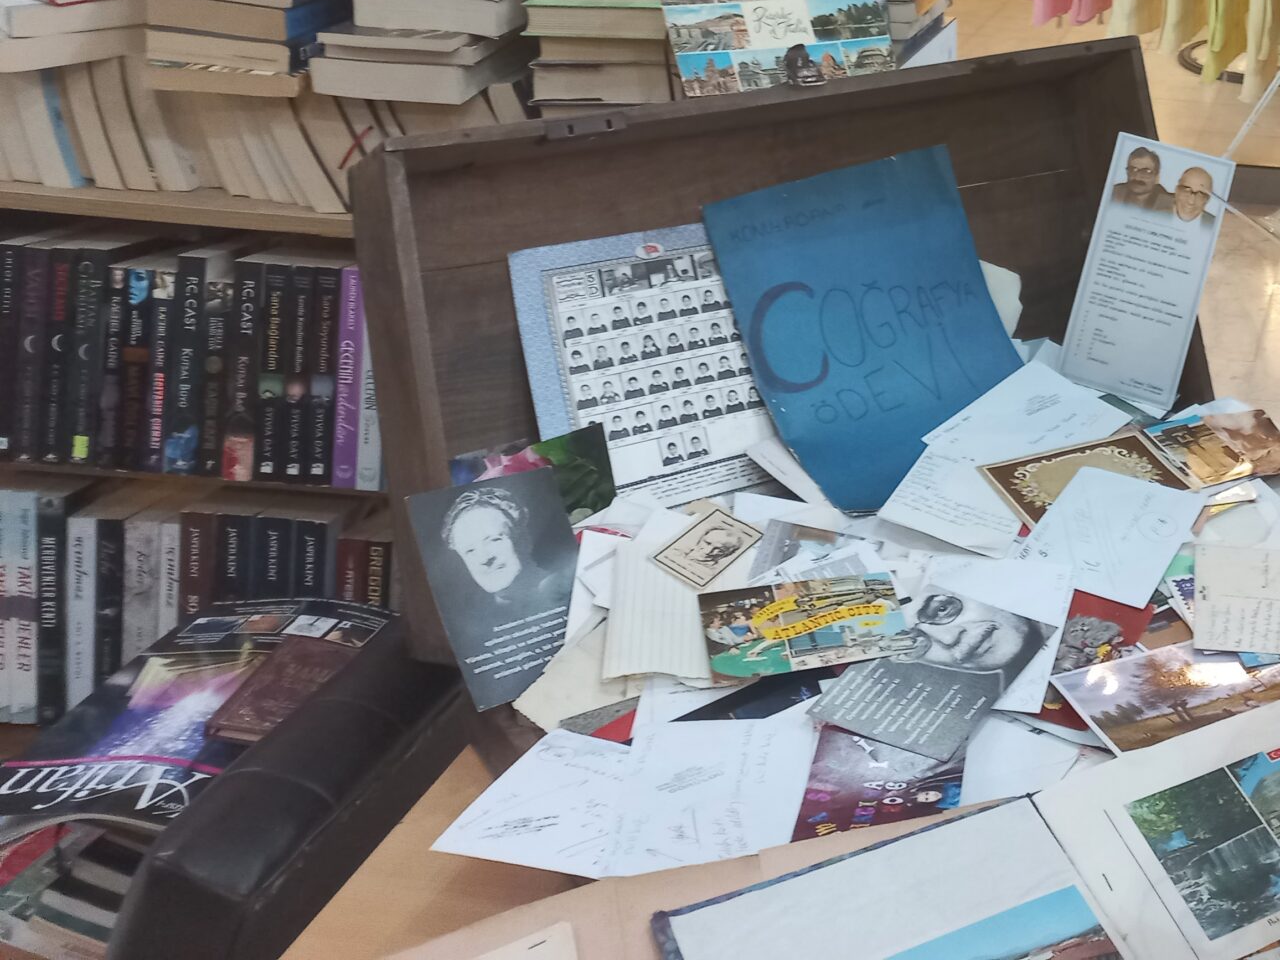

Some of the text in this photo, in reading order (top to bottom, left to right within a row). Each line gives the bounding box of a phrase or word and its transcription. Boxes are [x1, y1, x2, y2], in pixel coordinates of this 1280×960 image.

[183, 298, 198, 331] CAST
[239, 302, 254, 335] CAST
[750, 280, 978, 394] COĞRAFYA
[810, 321, 976, 424] ÖDEVİ
[188, 557, 199, 578] KENT
[225, 555, 237, 578] KENT
[266, 559, 277, 581] KENT
[304, 564, 315, 587] KENT
[773, 610, 847, 640] ATLANTIC
[847, 604, 883, 618] CITY
[0, 760, 212, 810] Arifan
